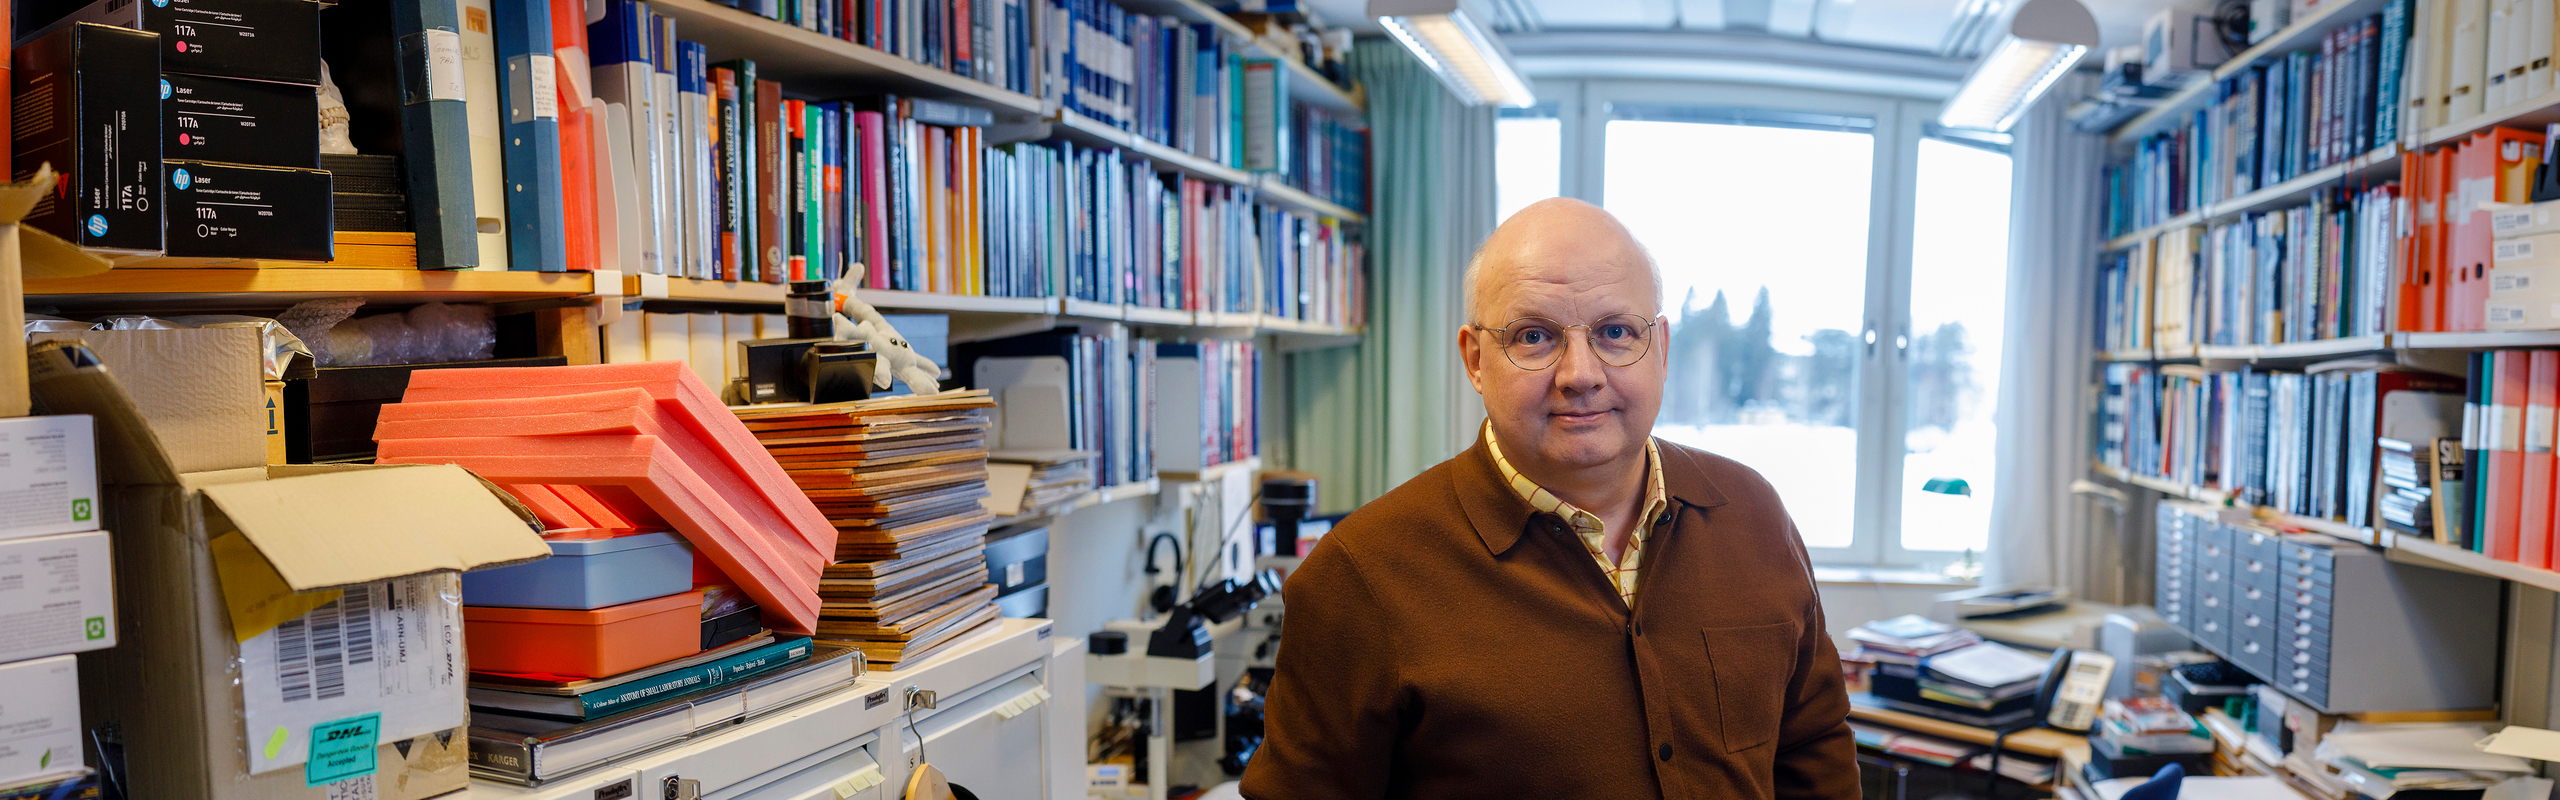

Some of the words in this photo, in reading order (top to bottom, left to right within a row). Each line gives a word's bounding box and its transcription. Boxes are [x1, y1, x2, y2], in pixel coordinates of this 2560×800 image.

[175, 25, 196, 37] 117A
[176, 86, 192, 94] Laser
[178, 116, 198, 128] 117A
[646, 111, 650, 124] 1
[668, 120, 674, 134] 2
[724, 105, 734, 172] CEREBRAL
[174, 168, 190, 190] hp
[195, 176, 211, 184] Laser
[122, 185, 132, 210] 117A
[727, 172, 735, 229] CORTEX
[196, 207, 217, 219] 117A
[88, 214, 108, 237] hp
[396, 599, 406, 663] SE-ARN-UMJ
[620, 690, 640, 702] ANATOMY
[640, 689, 645, 697] OF
[646, 686, 659, 696] SMALL
[659, 679, 683, 692] LABORATORY
[684, 675, 701, 686] ANIMALS
[327, 725, 363, 741] DHL
[328, 755, 356, 767] Accepted
[488, 753, 520, 768] KARGER
